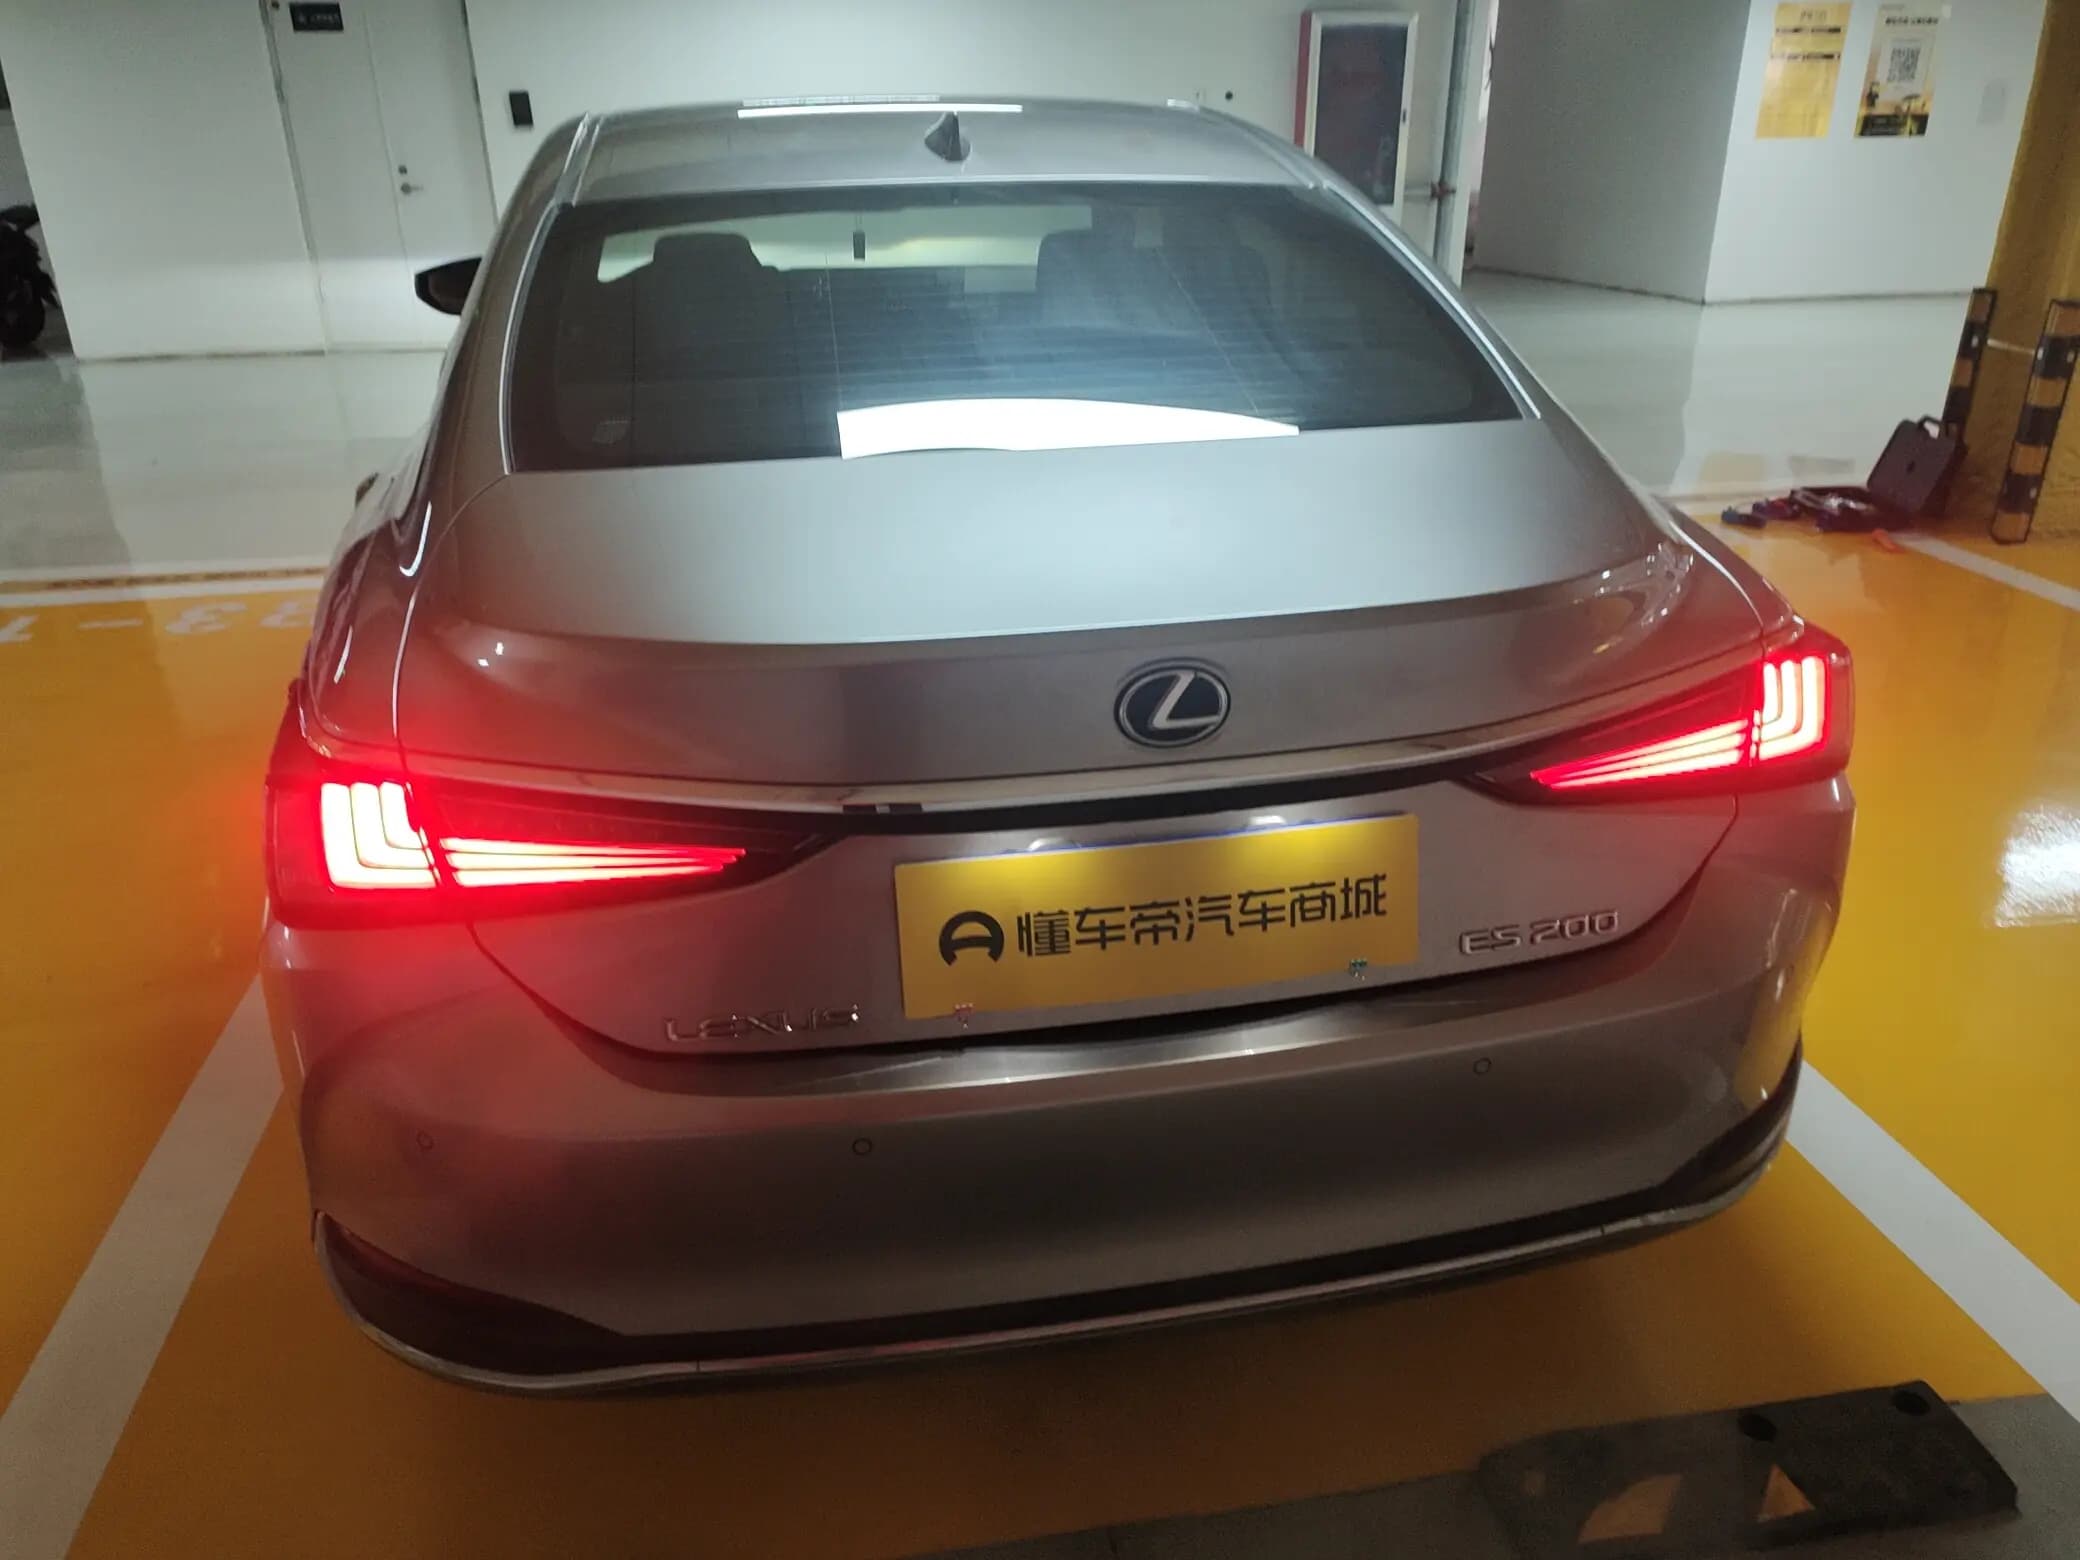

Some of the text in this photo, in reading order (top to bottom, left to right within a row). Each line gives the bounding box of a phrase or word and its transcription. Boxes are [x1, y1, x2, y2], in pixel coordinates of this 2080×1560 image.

[1016, 873, 1388, 958] 懂车帝汽车商城
[1459, 908, 1618, 955] ES 200
[663, 1003, 860, 1042] LEXUS
